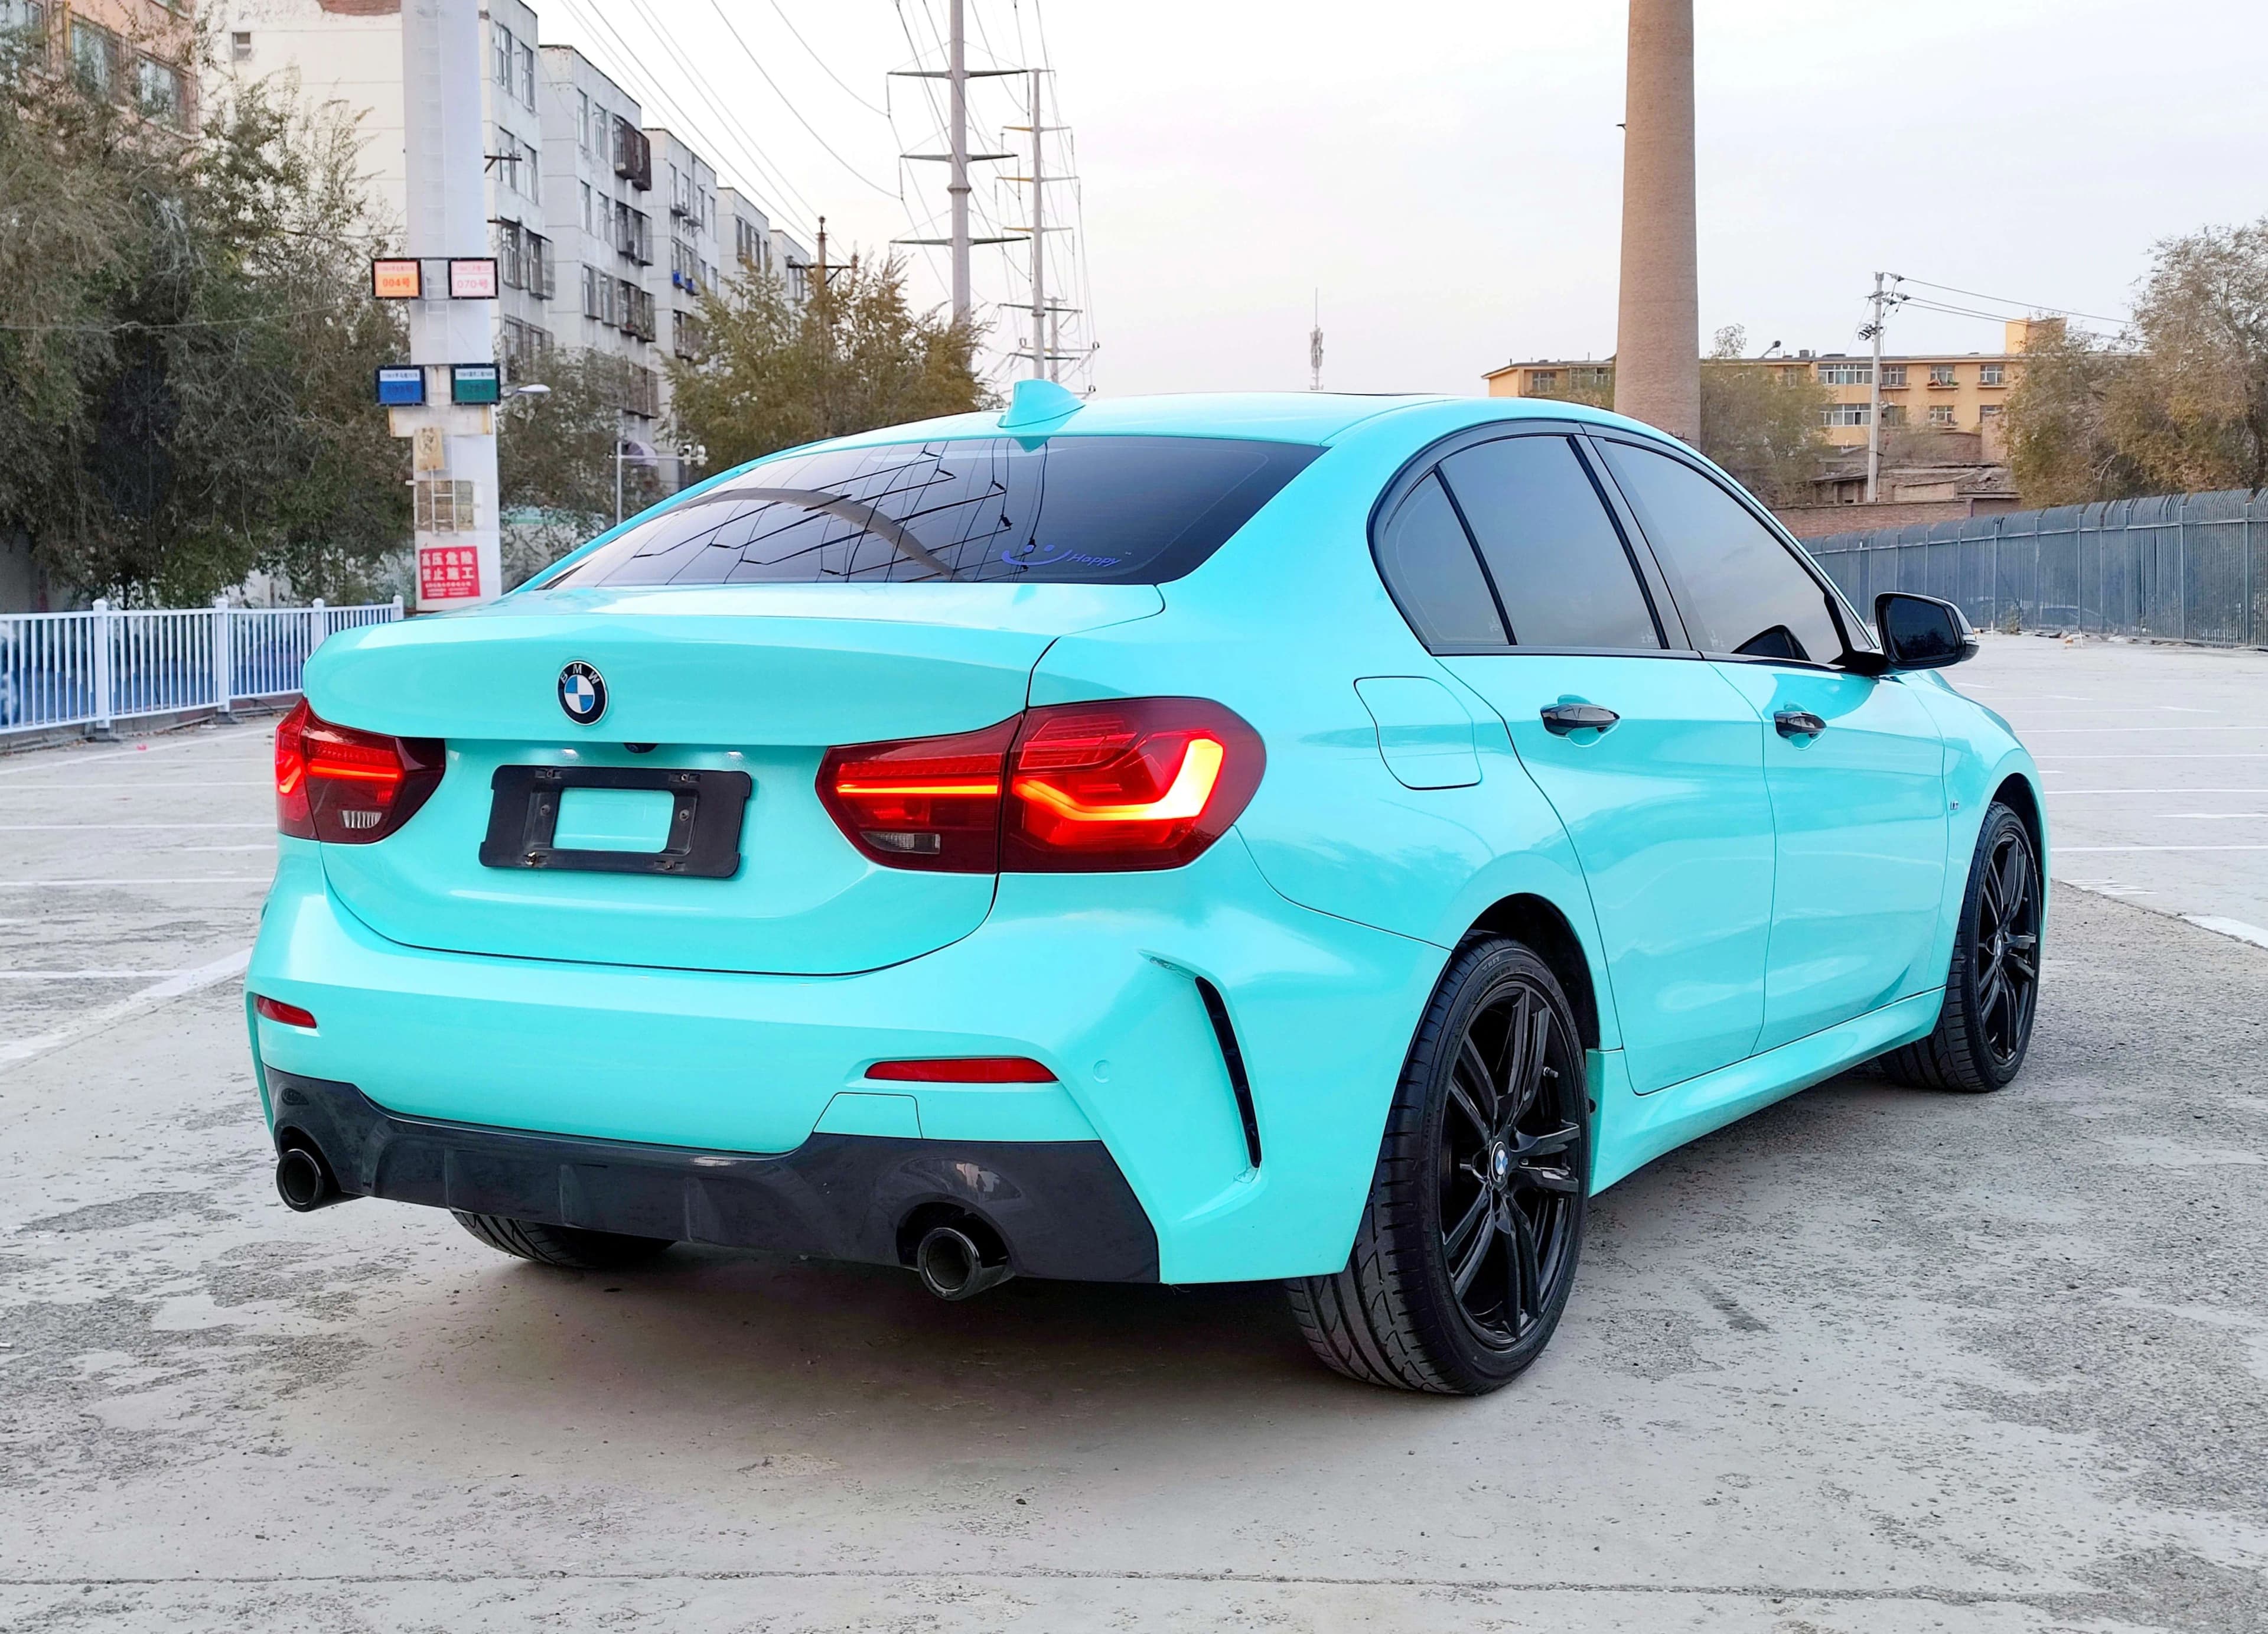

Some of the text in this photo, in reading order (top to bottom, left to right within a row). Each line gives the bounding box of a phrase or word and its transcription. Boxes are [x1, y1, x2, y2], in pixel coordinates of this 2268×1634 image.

[457, 279, 488, 289] 070号
[1066, 554, 1122, 567] Happy
[560, 663, 600, 685] BMW
